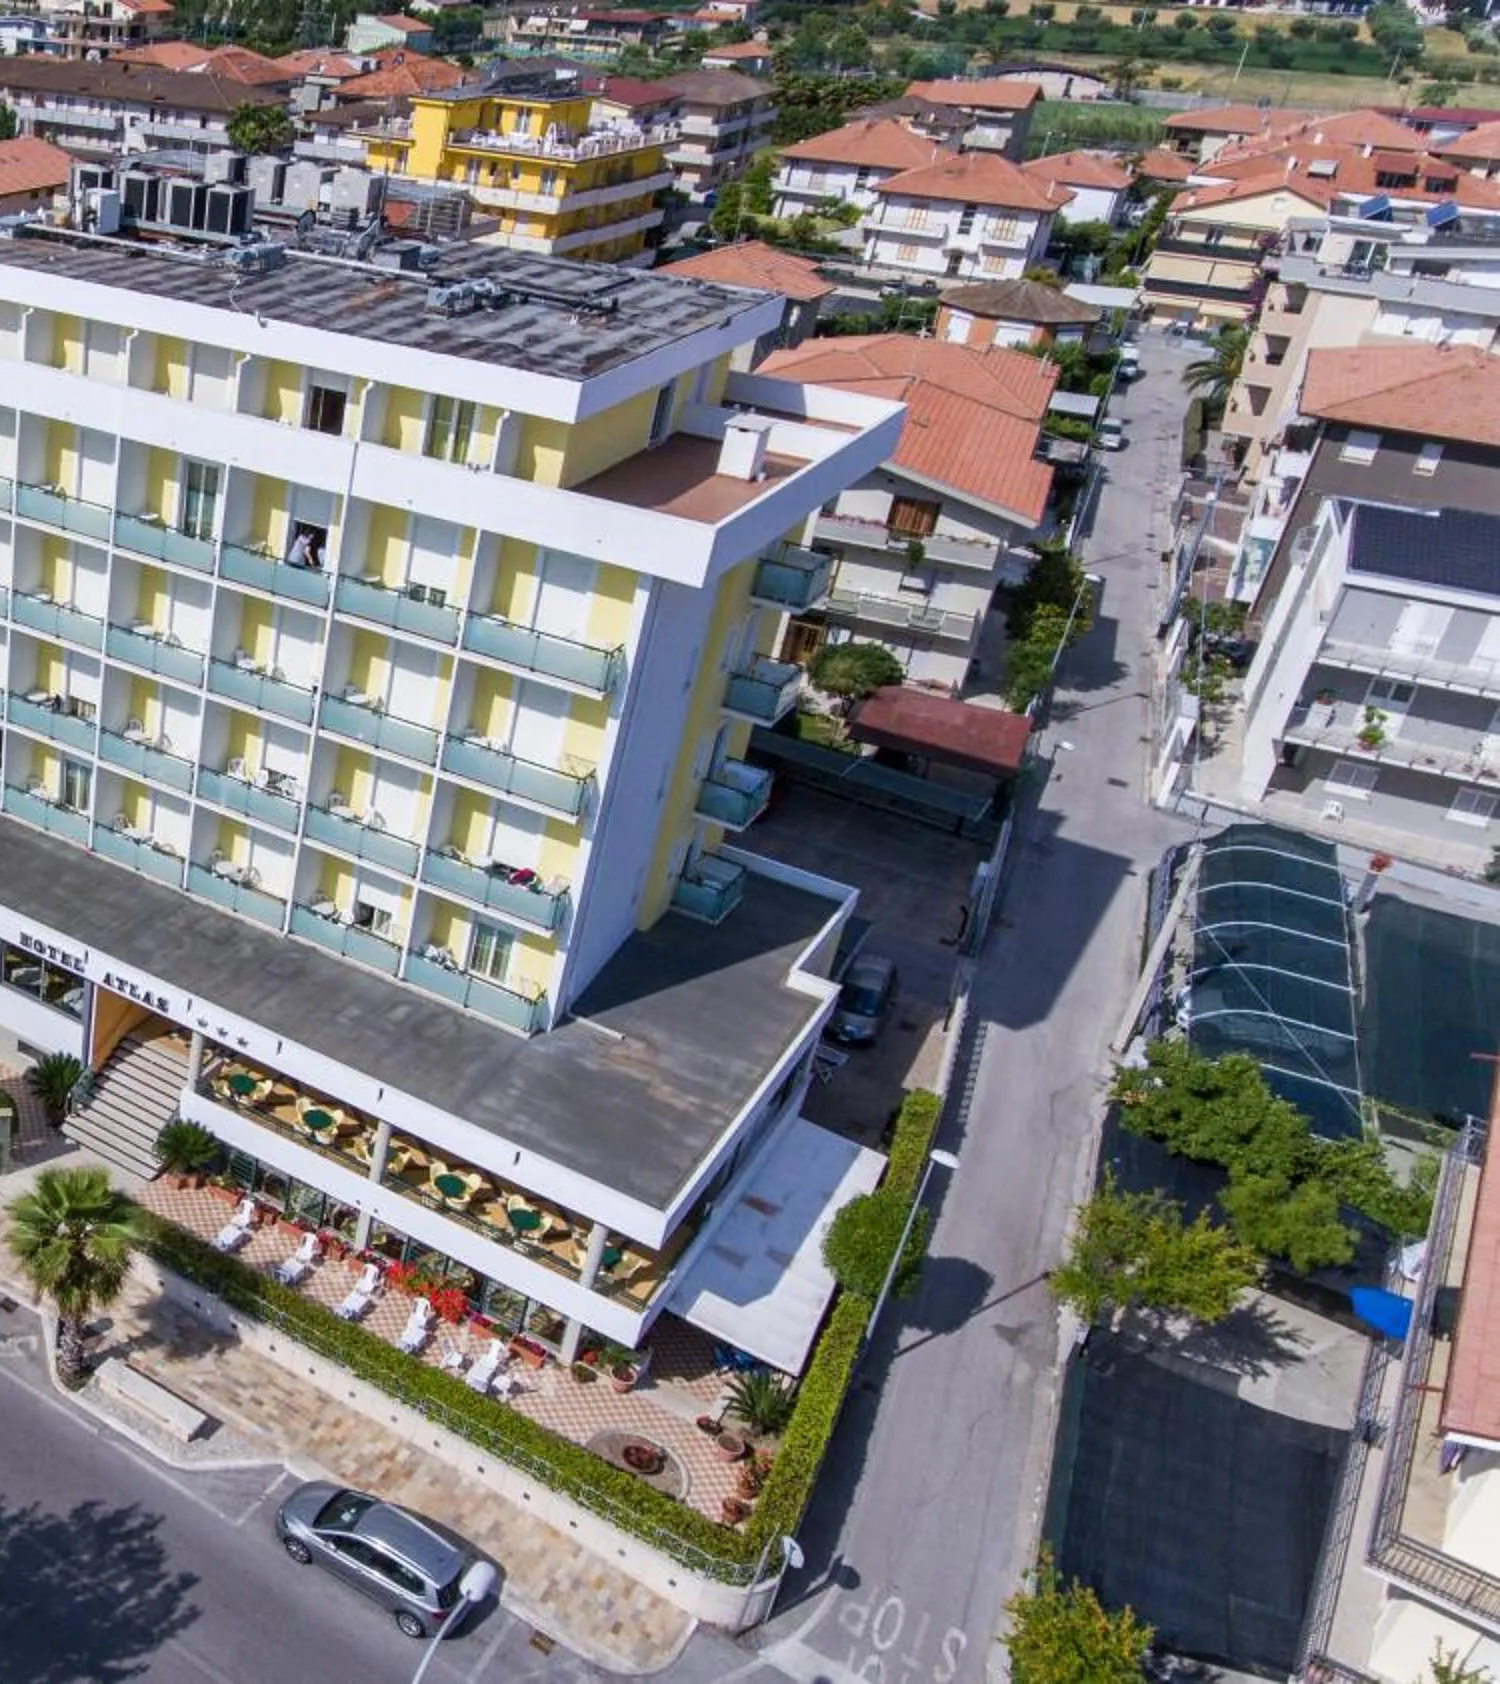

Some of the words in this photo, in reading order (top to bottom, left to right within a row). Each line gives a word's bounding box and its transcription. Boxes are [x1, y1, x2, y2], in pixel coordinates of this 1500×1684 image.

[20, 931, 85, 973] HOTEL
[103, 972, 168, 1013] ATLAS
[838, 1585, 967, 1683] STOP
